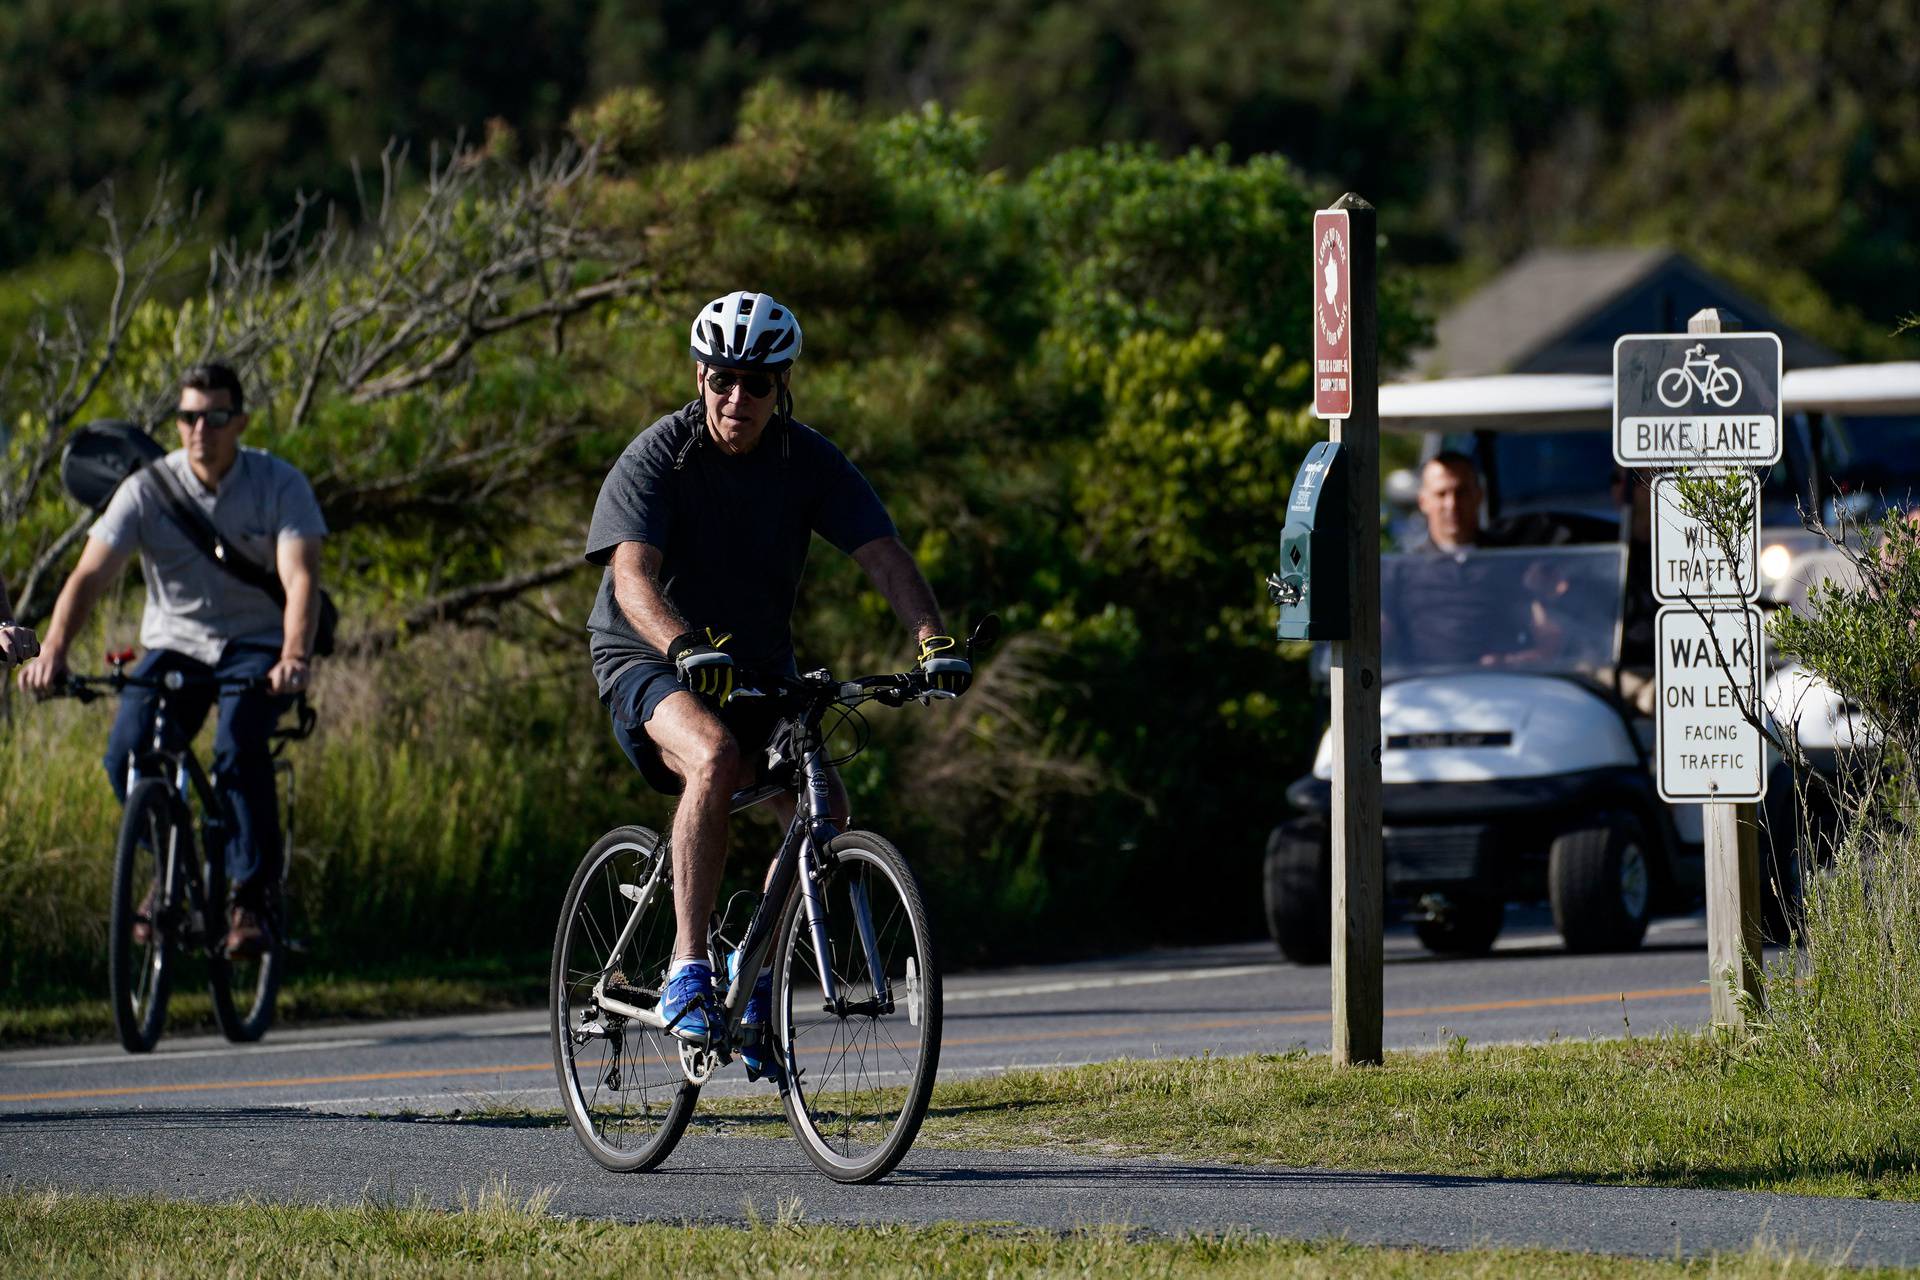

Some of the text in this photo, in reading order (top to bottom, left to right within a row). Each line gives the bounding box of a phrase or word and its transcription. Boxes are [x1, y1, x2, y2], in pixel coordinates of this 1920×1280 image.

[1637, 422, 1761, 451] BIKE LANE
[1684, 526, 1724, 549] WIT
[1670, 637, 1749, 668] WALK
[1667, 685, 1695, 708] ON
[1685, 725, 1738, 741] FACING
[1680, 754, 1744, 769] TRAFFIC
